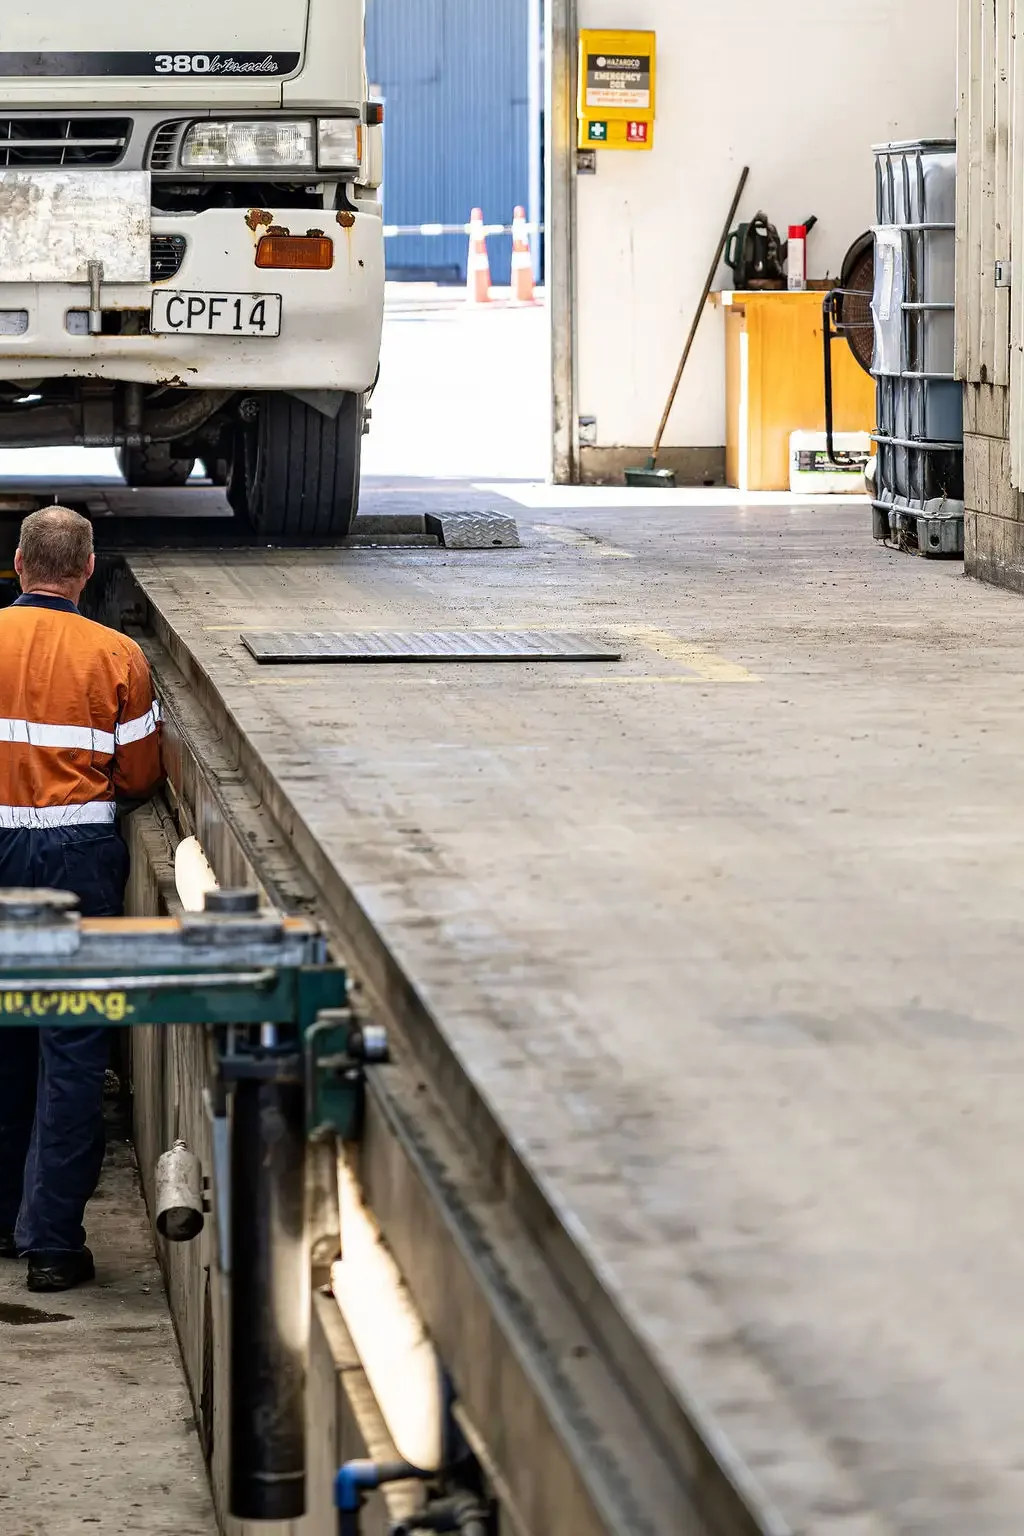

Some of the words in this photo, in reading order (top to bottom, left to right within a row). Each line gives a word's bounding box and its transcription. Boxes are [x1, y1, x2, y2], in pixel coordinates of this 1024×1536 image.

[155, 54, 210, 73] 380
[594, 71, 642, 81] EMERGENCY
[609, 80, 626, 89] BOX
[166, 296, 266, 331] CPF14
